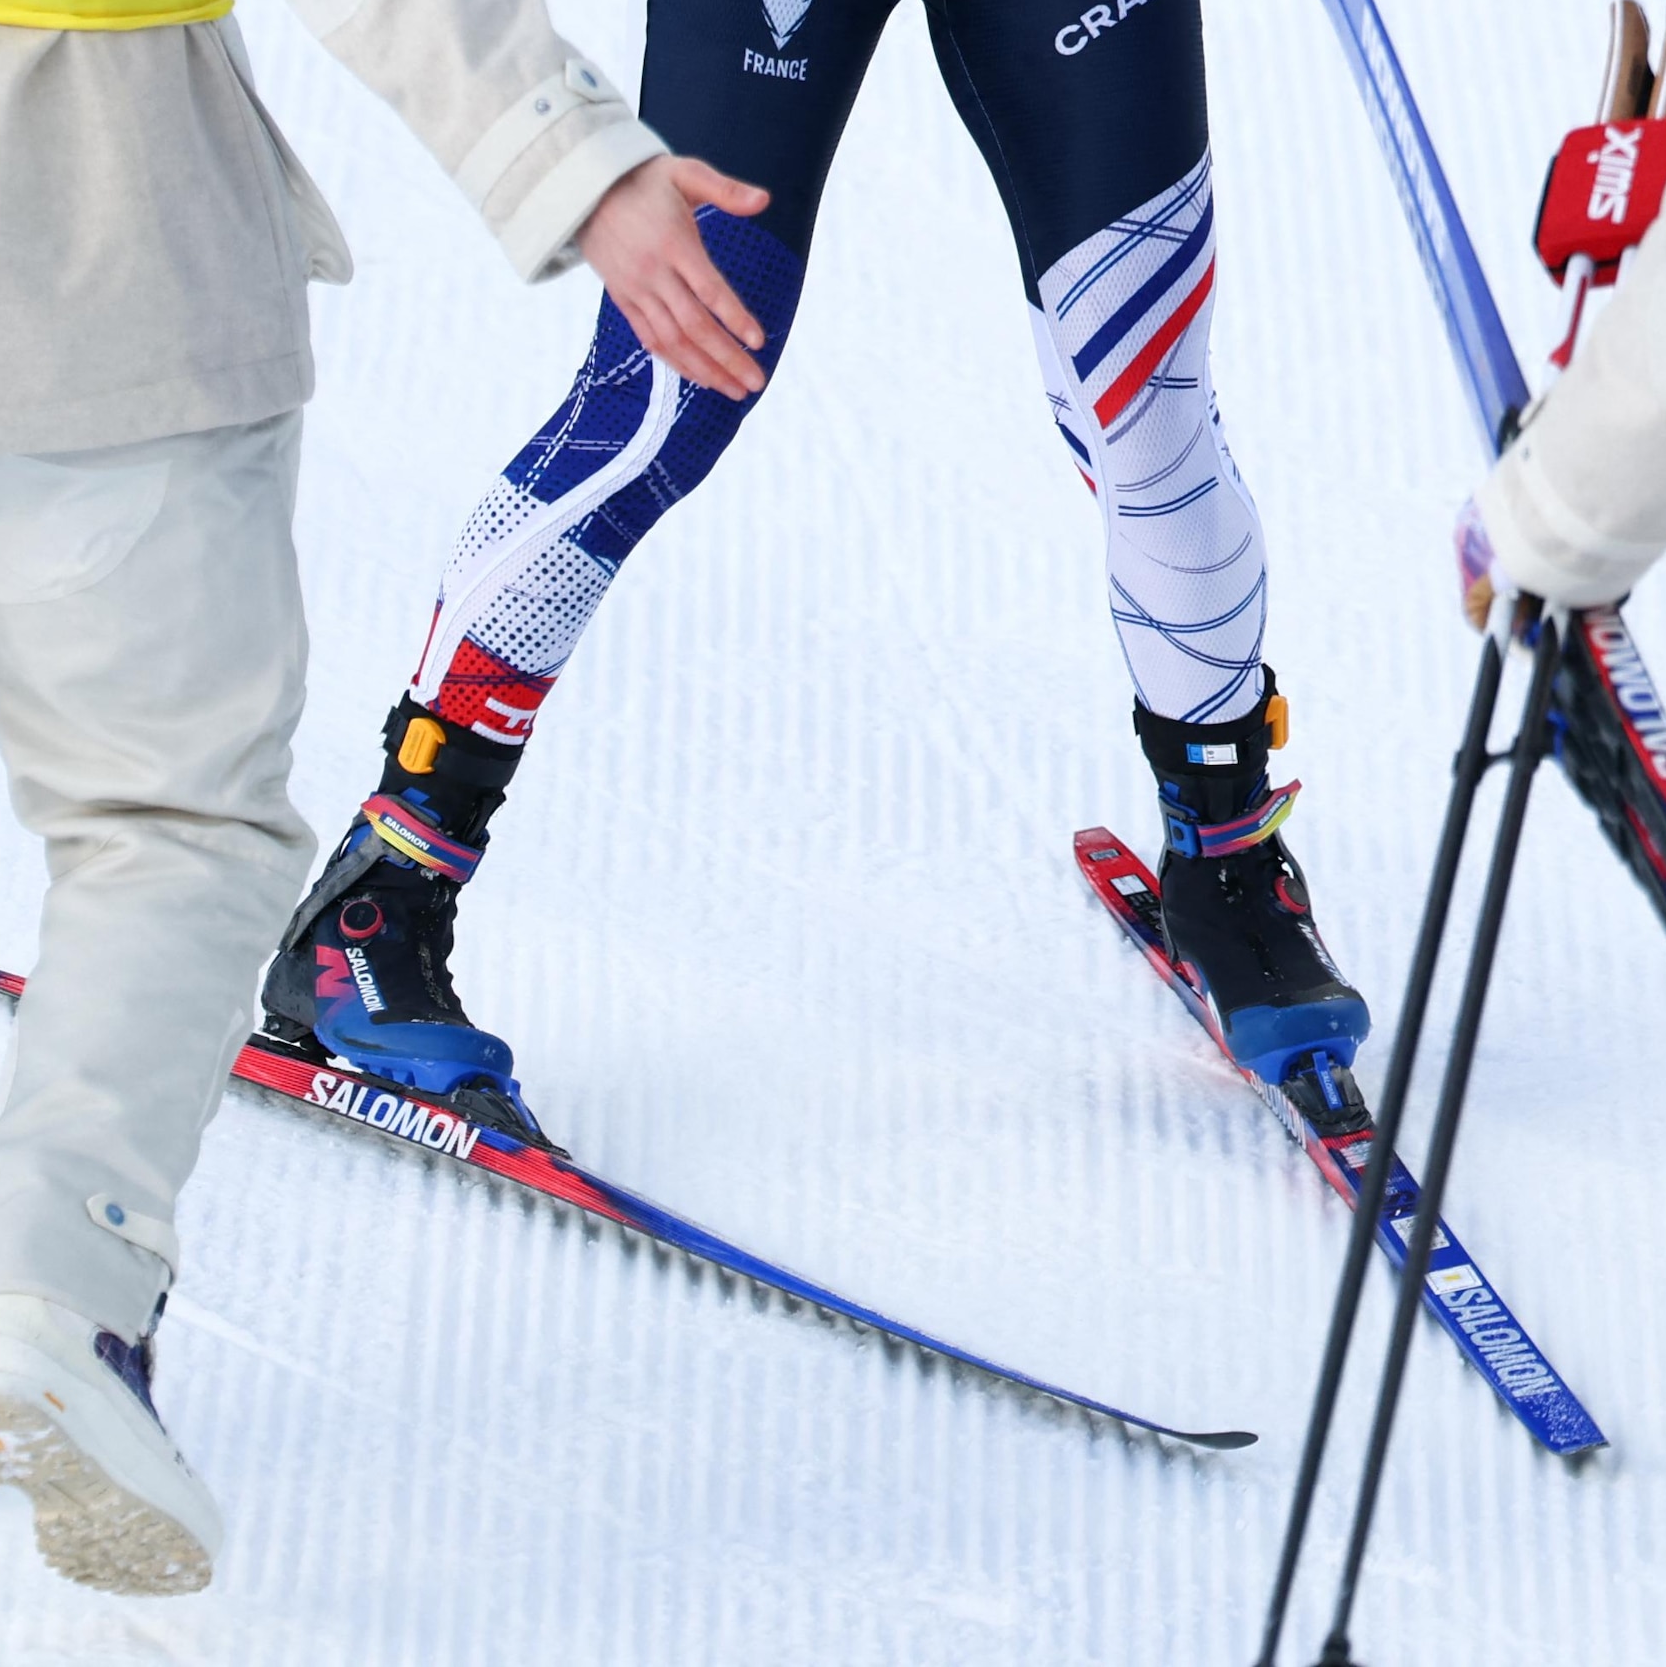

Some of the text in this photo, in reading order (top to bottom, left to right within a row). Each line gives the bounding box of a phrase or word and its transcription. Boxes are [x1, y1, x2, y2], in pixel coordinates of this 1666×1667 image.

[743, 47, 808, 81] FRANCE
[383, 815, 431, 852] SALOMON
[345, 946, 384, 1014] SALOMON
[303, 1072, 482, 1160] SALOMON
[1439, 1286, 1562, 1398] SALOMON
